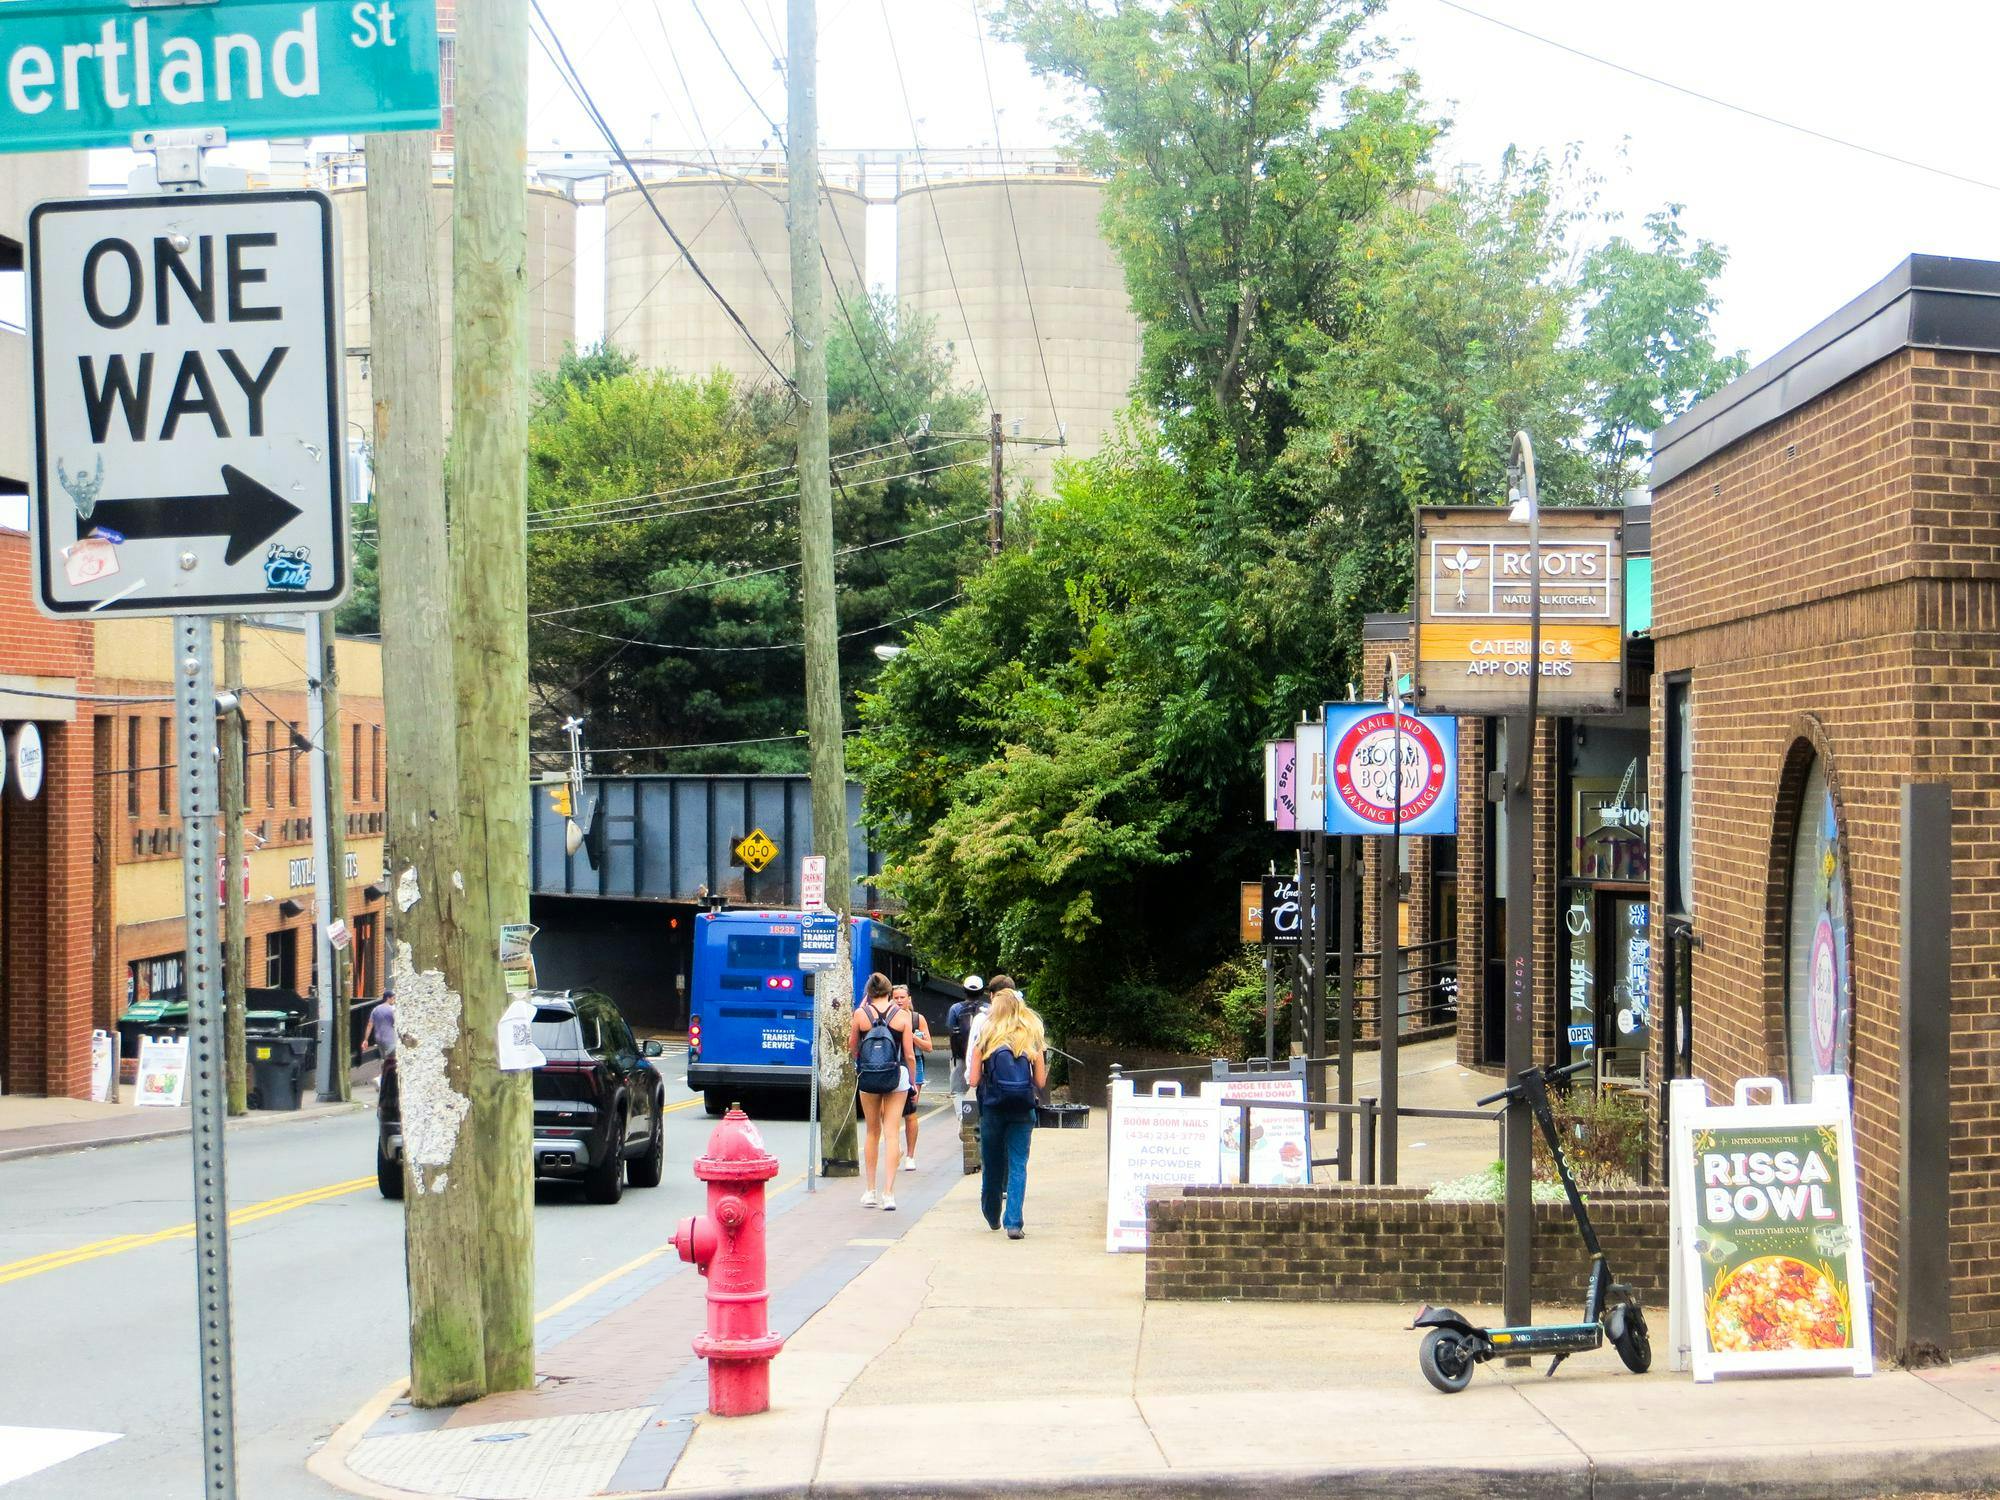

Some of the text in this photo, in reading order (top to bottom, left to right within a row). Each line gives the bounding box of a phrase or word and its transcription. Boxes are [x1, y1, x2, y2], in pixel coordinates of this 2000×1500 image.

[8, 1, 397, 115] ertland St
[82, 232, 283, 330] ONE
[78, 345, 290, 444] WAY
[1502, 552, 1597, 575] ROOTS
[1502, 594, 1597, 606] NATUAL KITCHEN
[1469, 639, 1573, 655] CATERIG &
[1466, 661, 1499, 676] APP
[1357, 717, 1422, 736] NAIL ND
[1360, 747, 1420, 767] BOOM
[1360, 769, 1420, 789] BOOM
[1342, 783, 1387, 821] WAXING
[1624, 807, 1650, 828] 109
[743, 845, 769, 857] 10-0
[802, 941, 835, 949] SERVICE
[803, 933, 836, 942] TRANSIT
[1570, 958, 1593, 1013] TAKE
[762, 1033, 796, 1041] TRANSIT
[1570, 1026, 1593, 1042] OPEN
[762, 1041, 796, 1049] SERVICE
[1227, 1082, 1255, 1090] MOGE
[1123, 1117, 1209, 1128] BOOM BOOM NAILS
[1731, 1137, 1783, 1145] INTRODUCING
[1141, 1146, 1190, 1155] ACRYLIC
[1128, 1159, 1201, 1168] DIP POWDER
[1703, 1150, 1832, 1187] RISSA
[1133, 1173, 1195, 1182] MANICURE
[1705, 1184, 1837, 1223] BOWL
[1735, 1228, 1765, 1236] LIMITED
[1766, 1227, 1784, 1235] TIME
